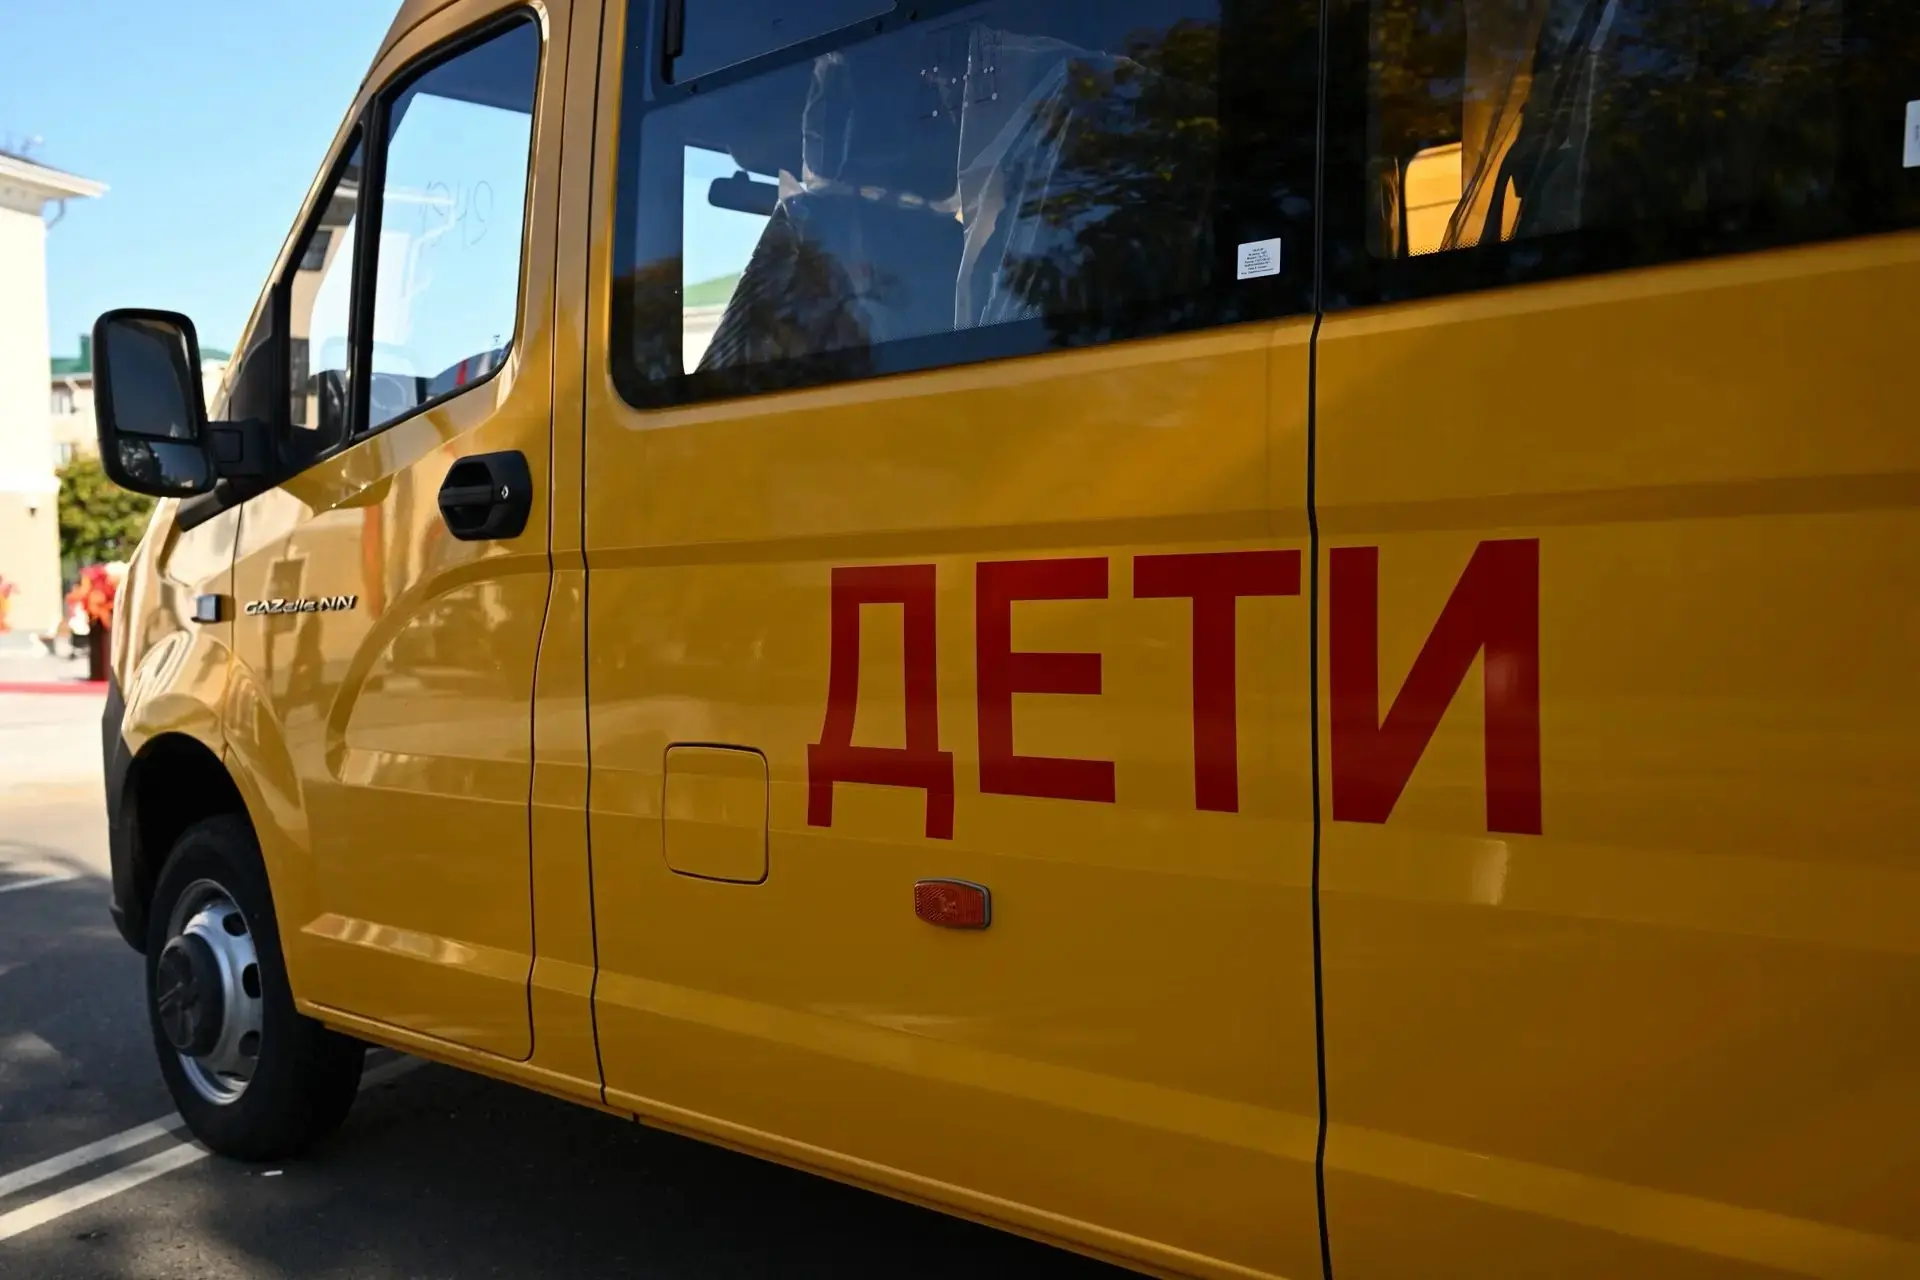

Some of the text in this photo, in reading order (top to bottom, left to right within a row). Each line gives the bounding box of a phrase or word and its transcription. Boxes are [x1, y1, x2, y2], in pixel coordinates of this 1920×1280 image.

[244, 595, 358, 615] GAZelle NN
[808, 539, 1542, 840] ДЕТИ
